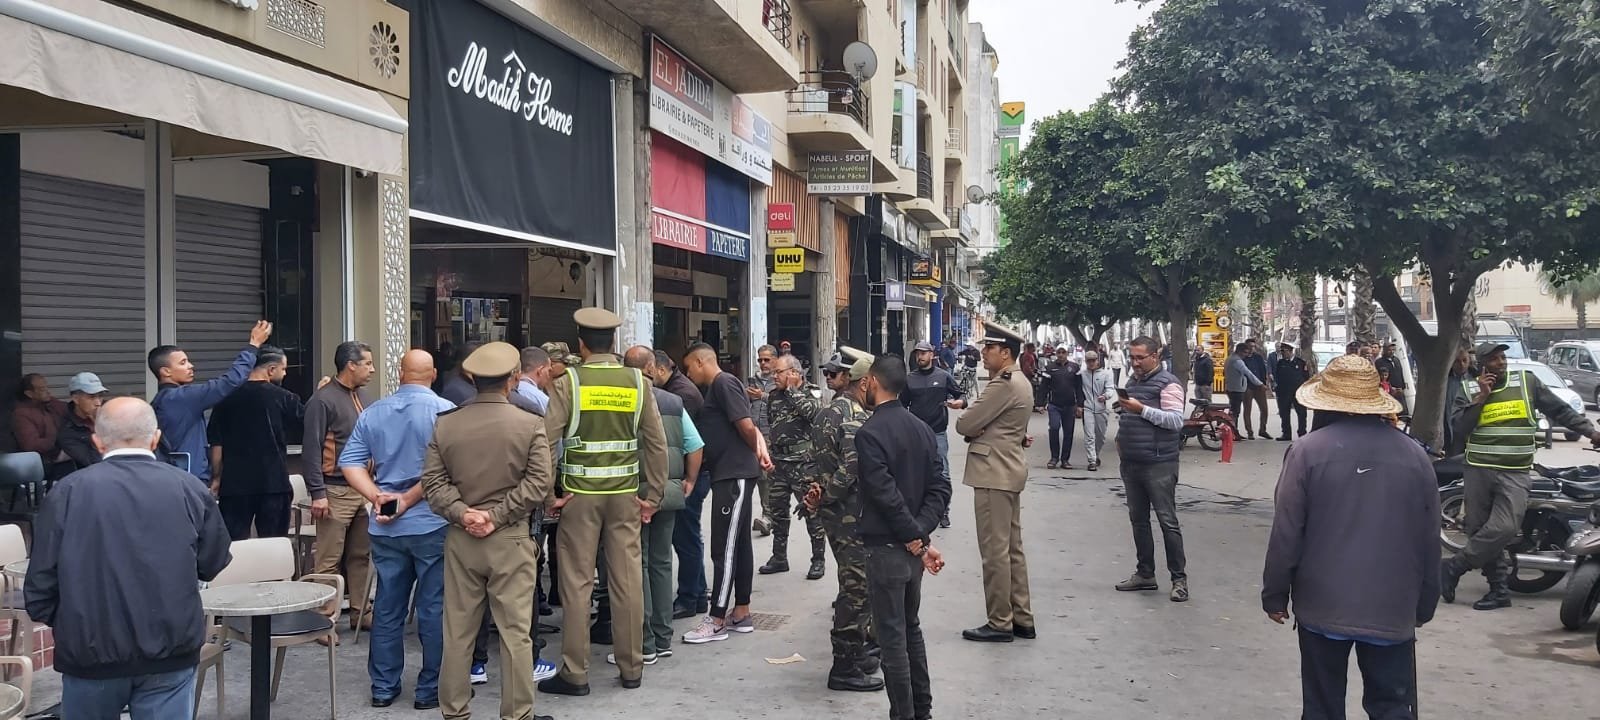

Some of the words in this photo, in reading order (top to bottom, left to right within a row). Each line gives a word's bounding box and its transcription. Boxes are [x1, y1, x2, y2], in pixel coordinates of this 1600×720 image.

[447, 41, 522, 113] Madih
[523, 72, 573, 136] Home
[655, 48, 673, 86] EL
[674, 63, 713, 113] JADIDA
[651, 92, 682, 122] LIBRAIRIE
[681, 110, 688, 125] &
[687, 113, 715, 141] PAPETERIE
[845, 154, 869, 162] SPORT
[770, 211, 791, 221] deli
[653, 215, 698, 248] LIBRAIRIE
[711, 231, 746, 259] PAPETERIE
[776, 254, 801, 264] UHU
